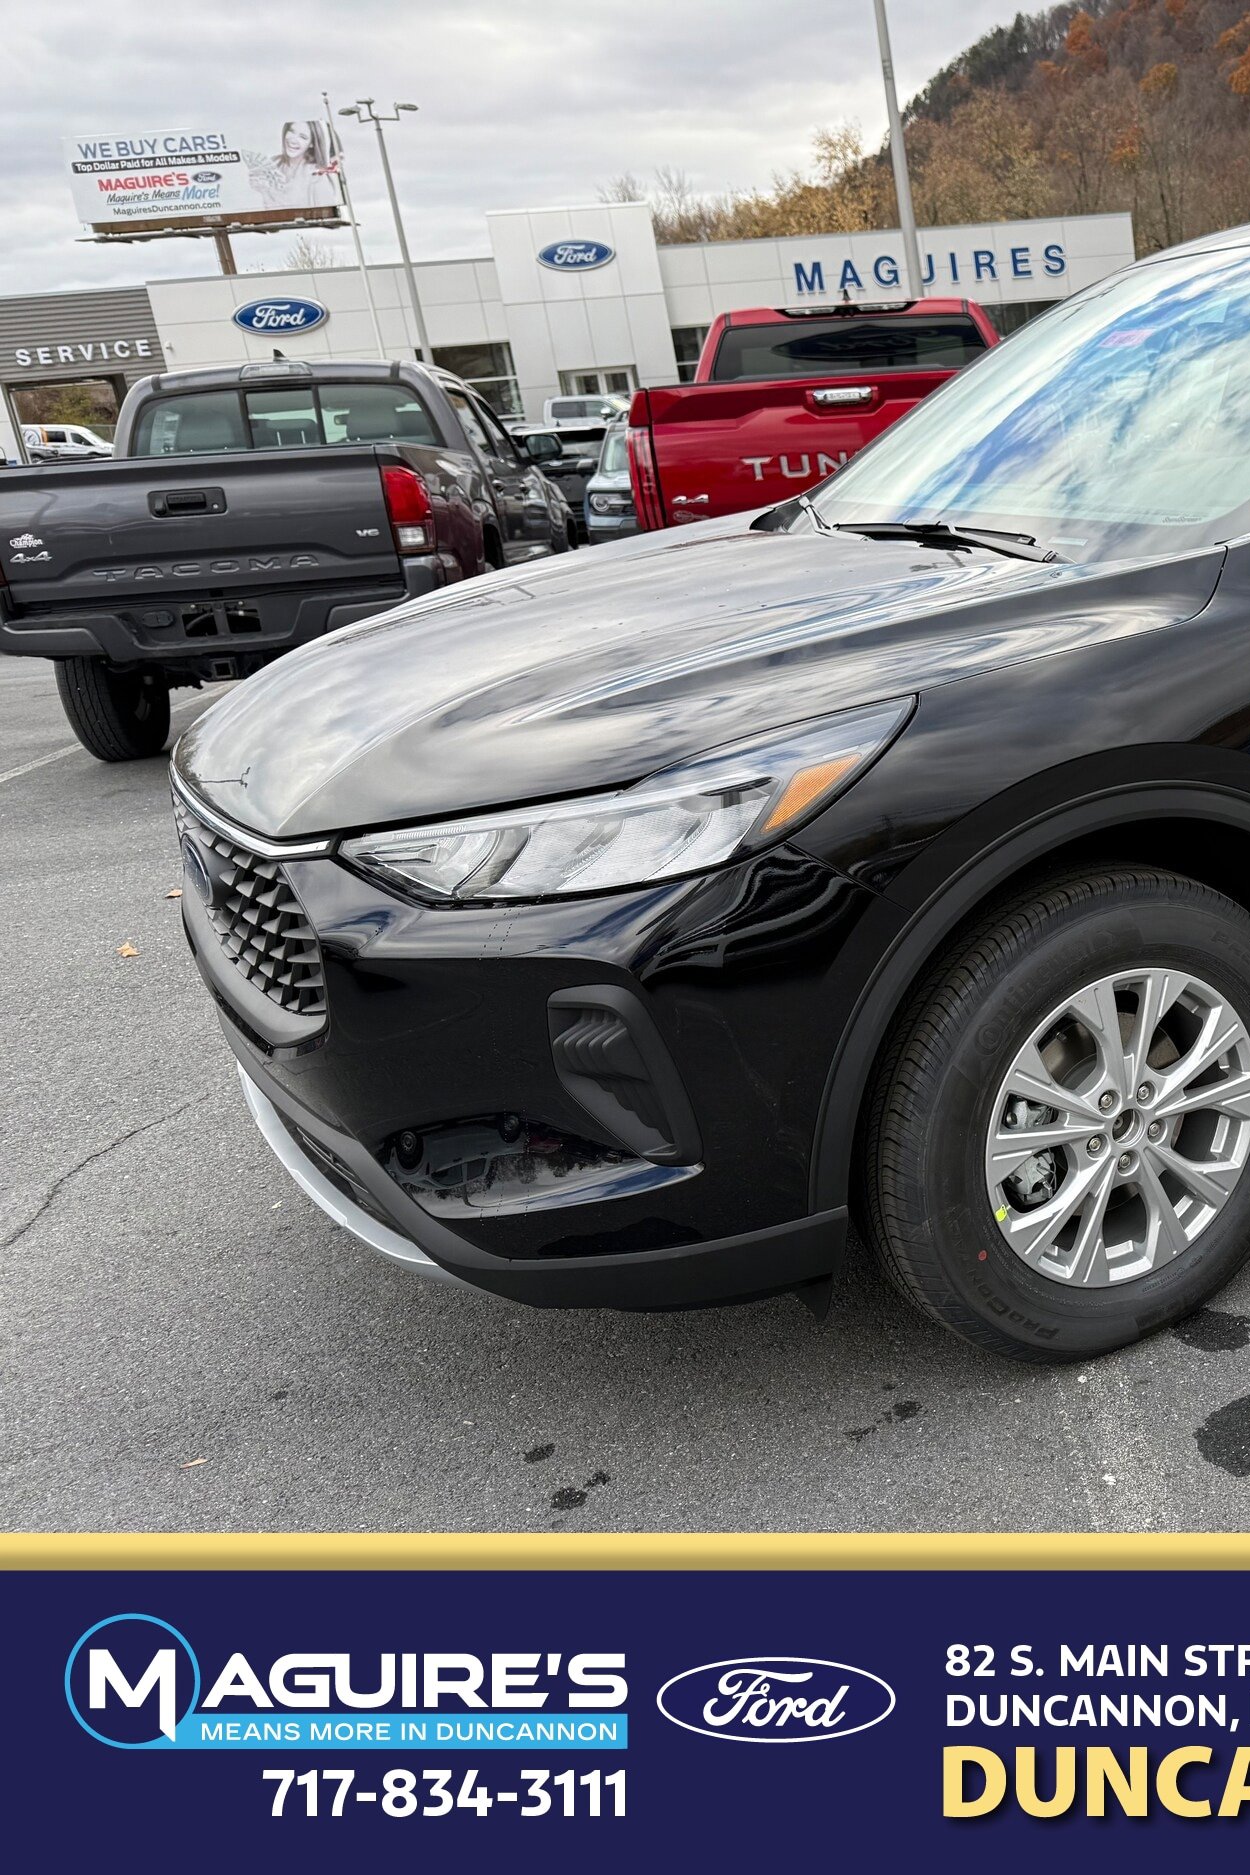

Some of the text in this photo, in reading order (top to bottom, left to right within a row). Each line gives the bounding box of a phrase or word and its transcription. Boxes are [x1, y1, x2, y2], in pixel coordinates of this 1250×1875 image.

[77, 133, 227, 159] WE BUY CARS!
[75, 153, 238, 173] Top Dollar Paid for All Makes & Models
[97, 172, 217, 192] MAGUIRE'S Ford
[107, 184, 220, 205] Maguire's Means More!
[113, 201, 221, 217] MaguiresDuncannon.com
[554, 244, 598, 264] Ford
[793, 245, 1069, 293] MAGUIRES
[252, 303, 305, 329] Ford
[16, 338, 153, 368] SERVICE
[740, 451, 849, 482] TUN
[356, 529, 380, 537] V6
[10, 551, 53, 563] 4x4
[93, 554, 320, 582] TACOMA
